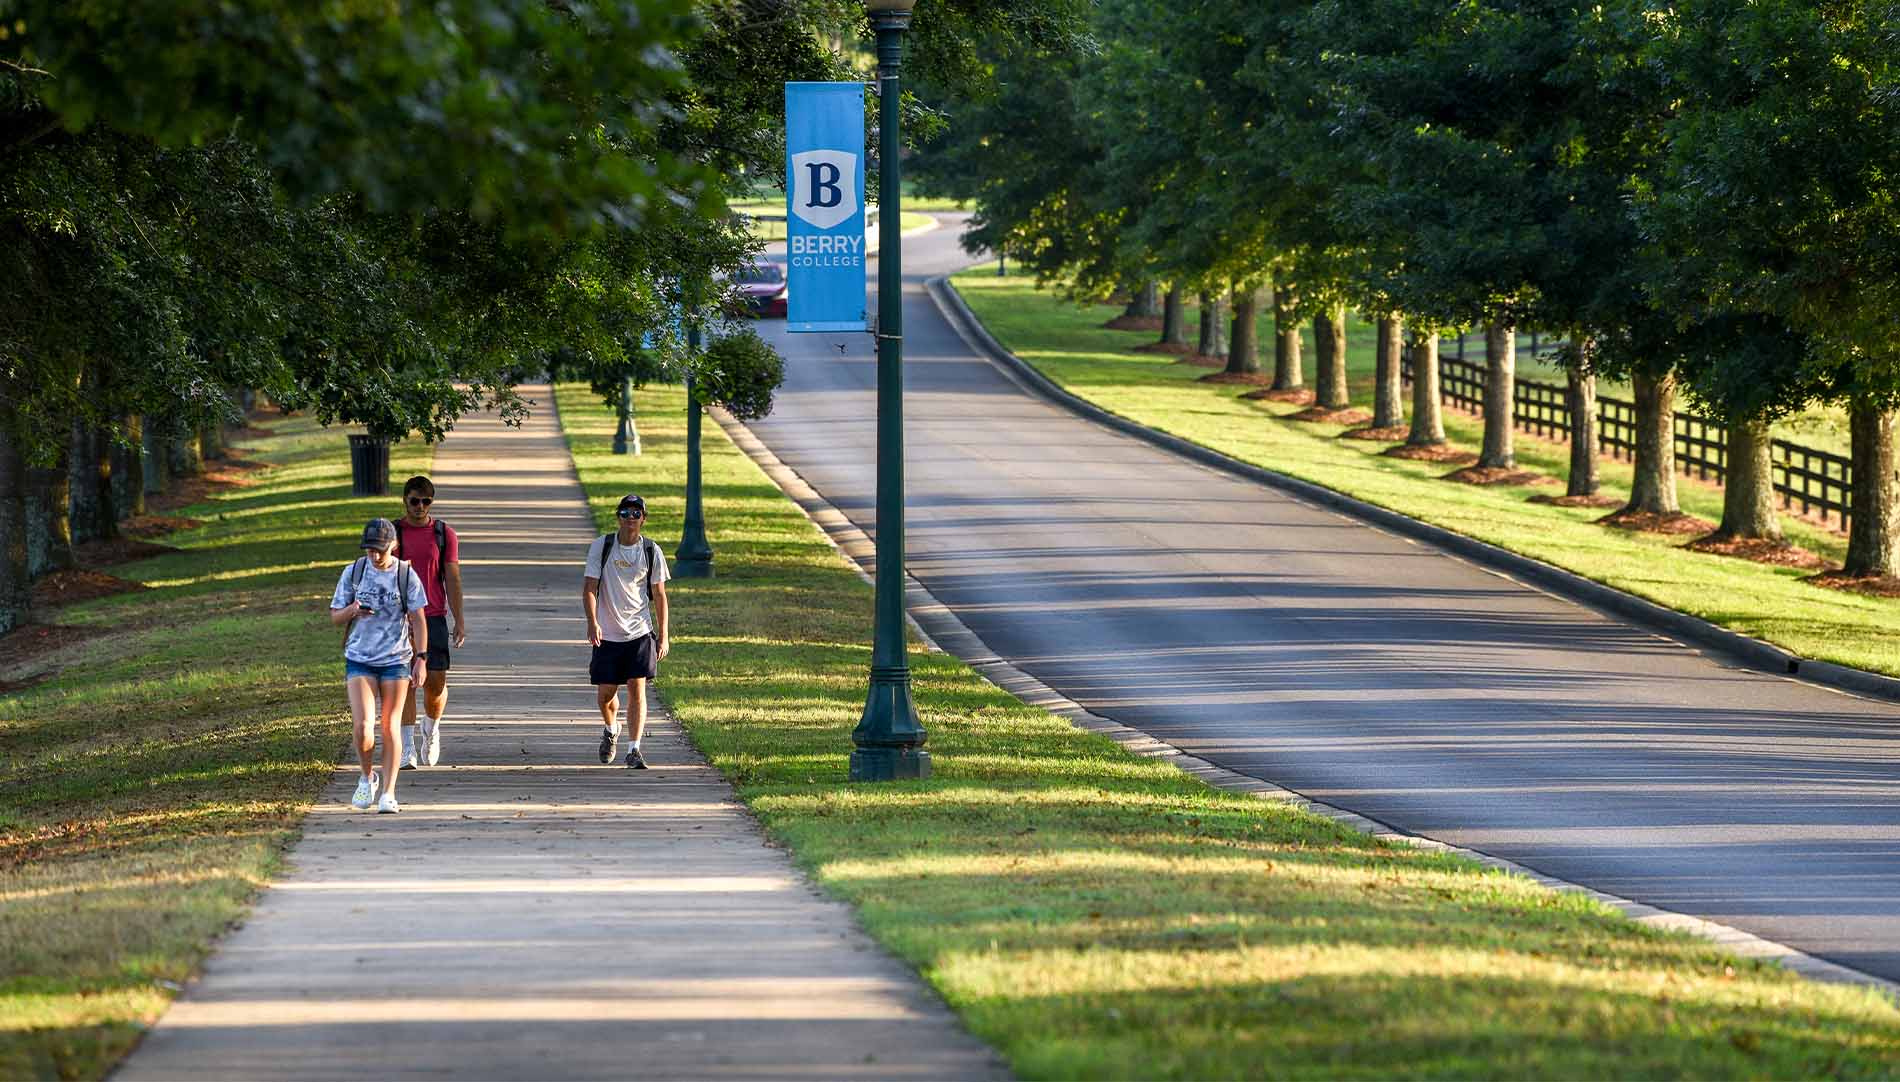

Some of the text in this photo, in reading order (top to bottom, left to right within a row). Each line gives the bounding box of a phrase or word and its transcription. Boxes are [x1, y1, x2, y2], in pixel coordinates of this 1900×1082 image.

[805, 162, 842, 208] B
[792, 235, 862, 254] BERRY
[792, 256, 860, 267] COLLEGE
